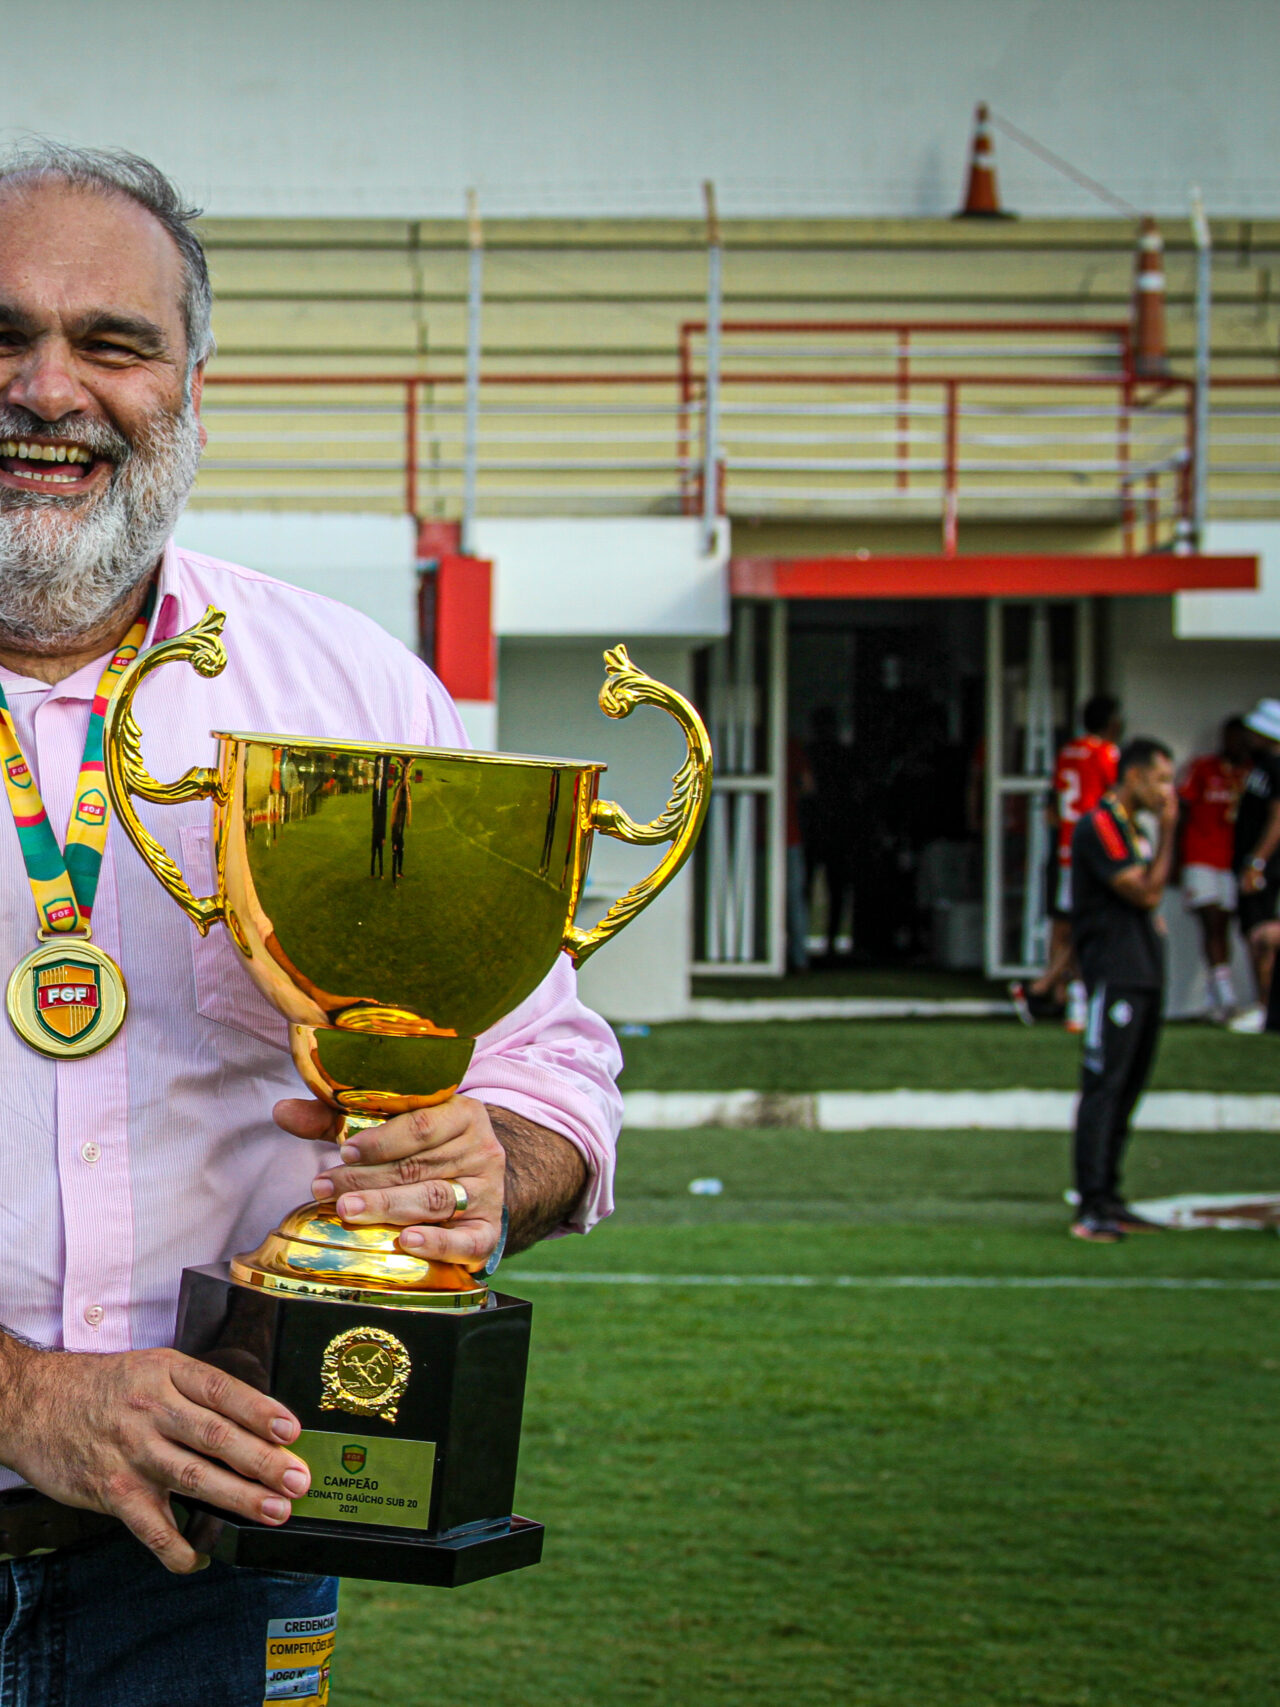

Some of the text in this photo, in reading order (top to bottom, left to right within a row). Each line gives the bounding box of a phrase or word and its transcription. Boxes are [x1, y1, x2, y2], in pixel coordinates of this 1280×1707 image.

[51, 908, 70, 920] FGF
[47, 987, 87, 1003] FGF
[323, 1475, 379, 1490] CAMPEÃO
[306, 1489, 418, 1508] EONATO GAÚCHO SUB 20
[338, 1504, 358, 1513] 2021
[269, 1672, 295, 1681] JOGO
